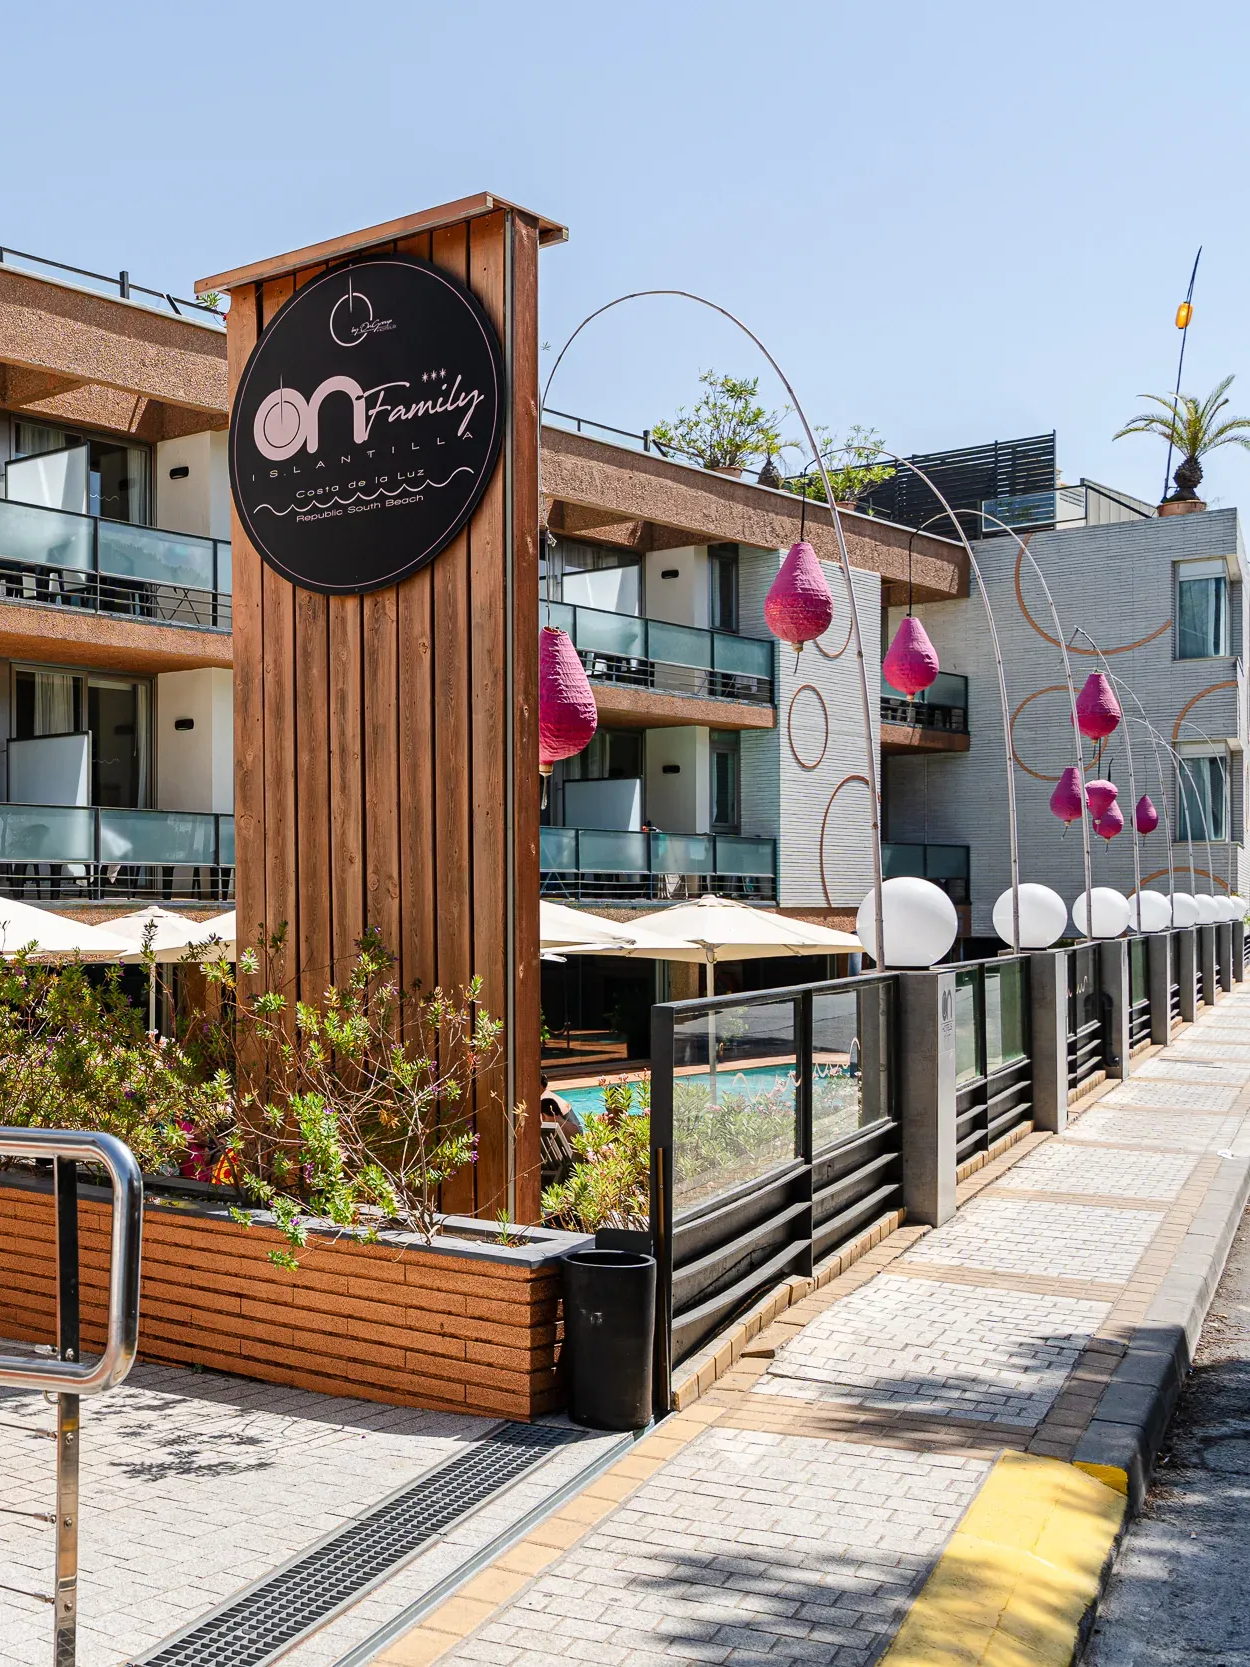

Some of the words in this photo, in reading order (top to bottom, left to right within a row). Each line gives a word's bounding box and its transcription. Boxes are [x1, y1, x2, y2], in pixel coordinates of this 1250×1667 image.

[356, 374, 484, 440] Family
[252, 431, 473, 482] ISLANTILLA
[296, 485, 339, 498] Costa
[348, 480, 366, 489] de
[375, 476, 388, 484] la
[397, 469, 425, 480] Luz
[296, 509, 343, 522] Republic
[347, 502, 381, 514] South
[385, 494, 424, 507] Beach
